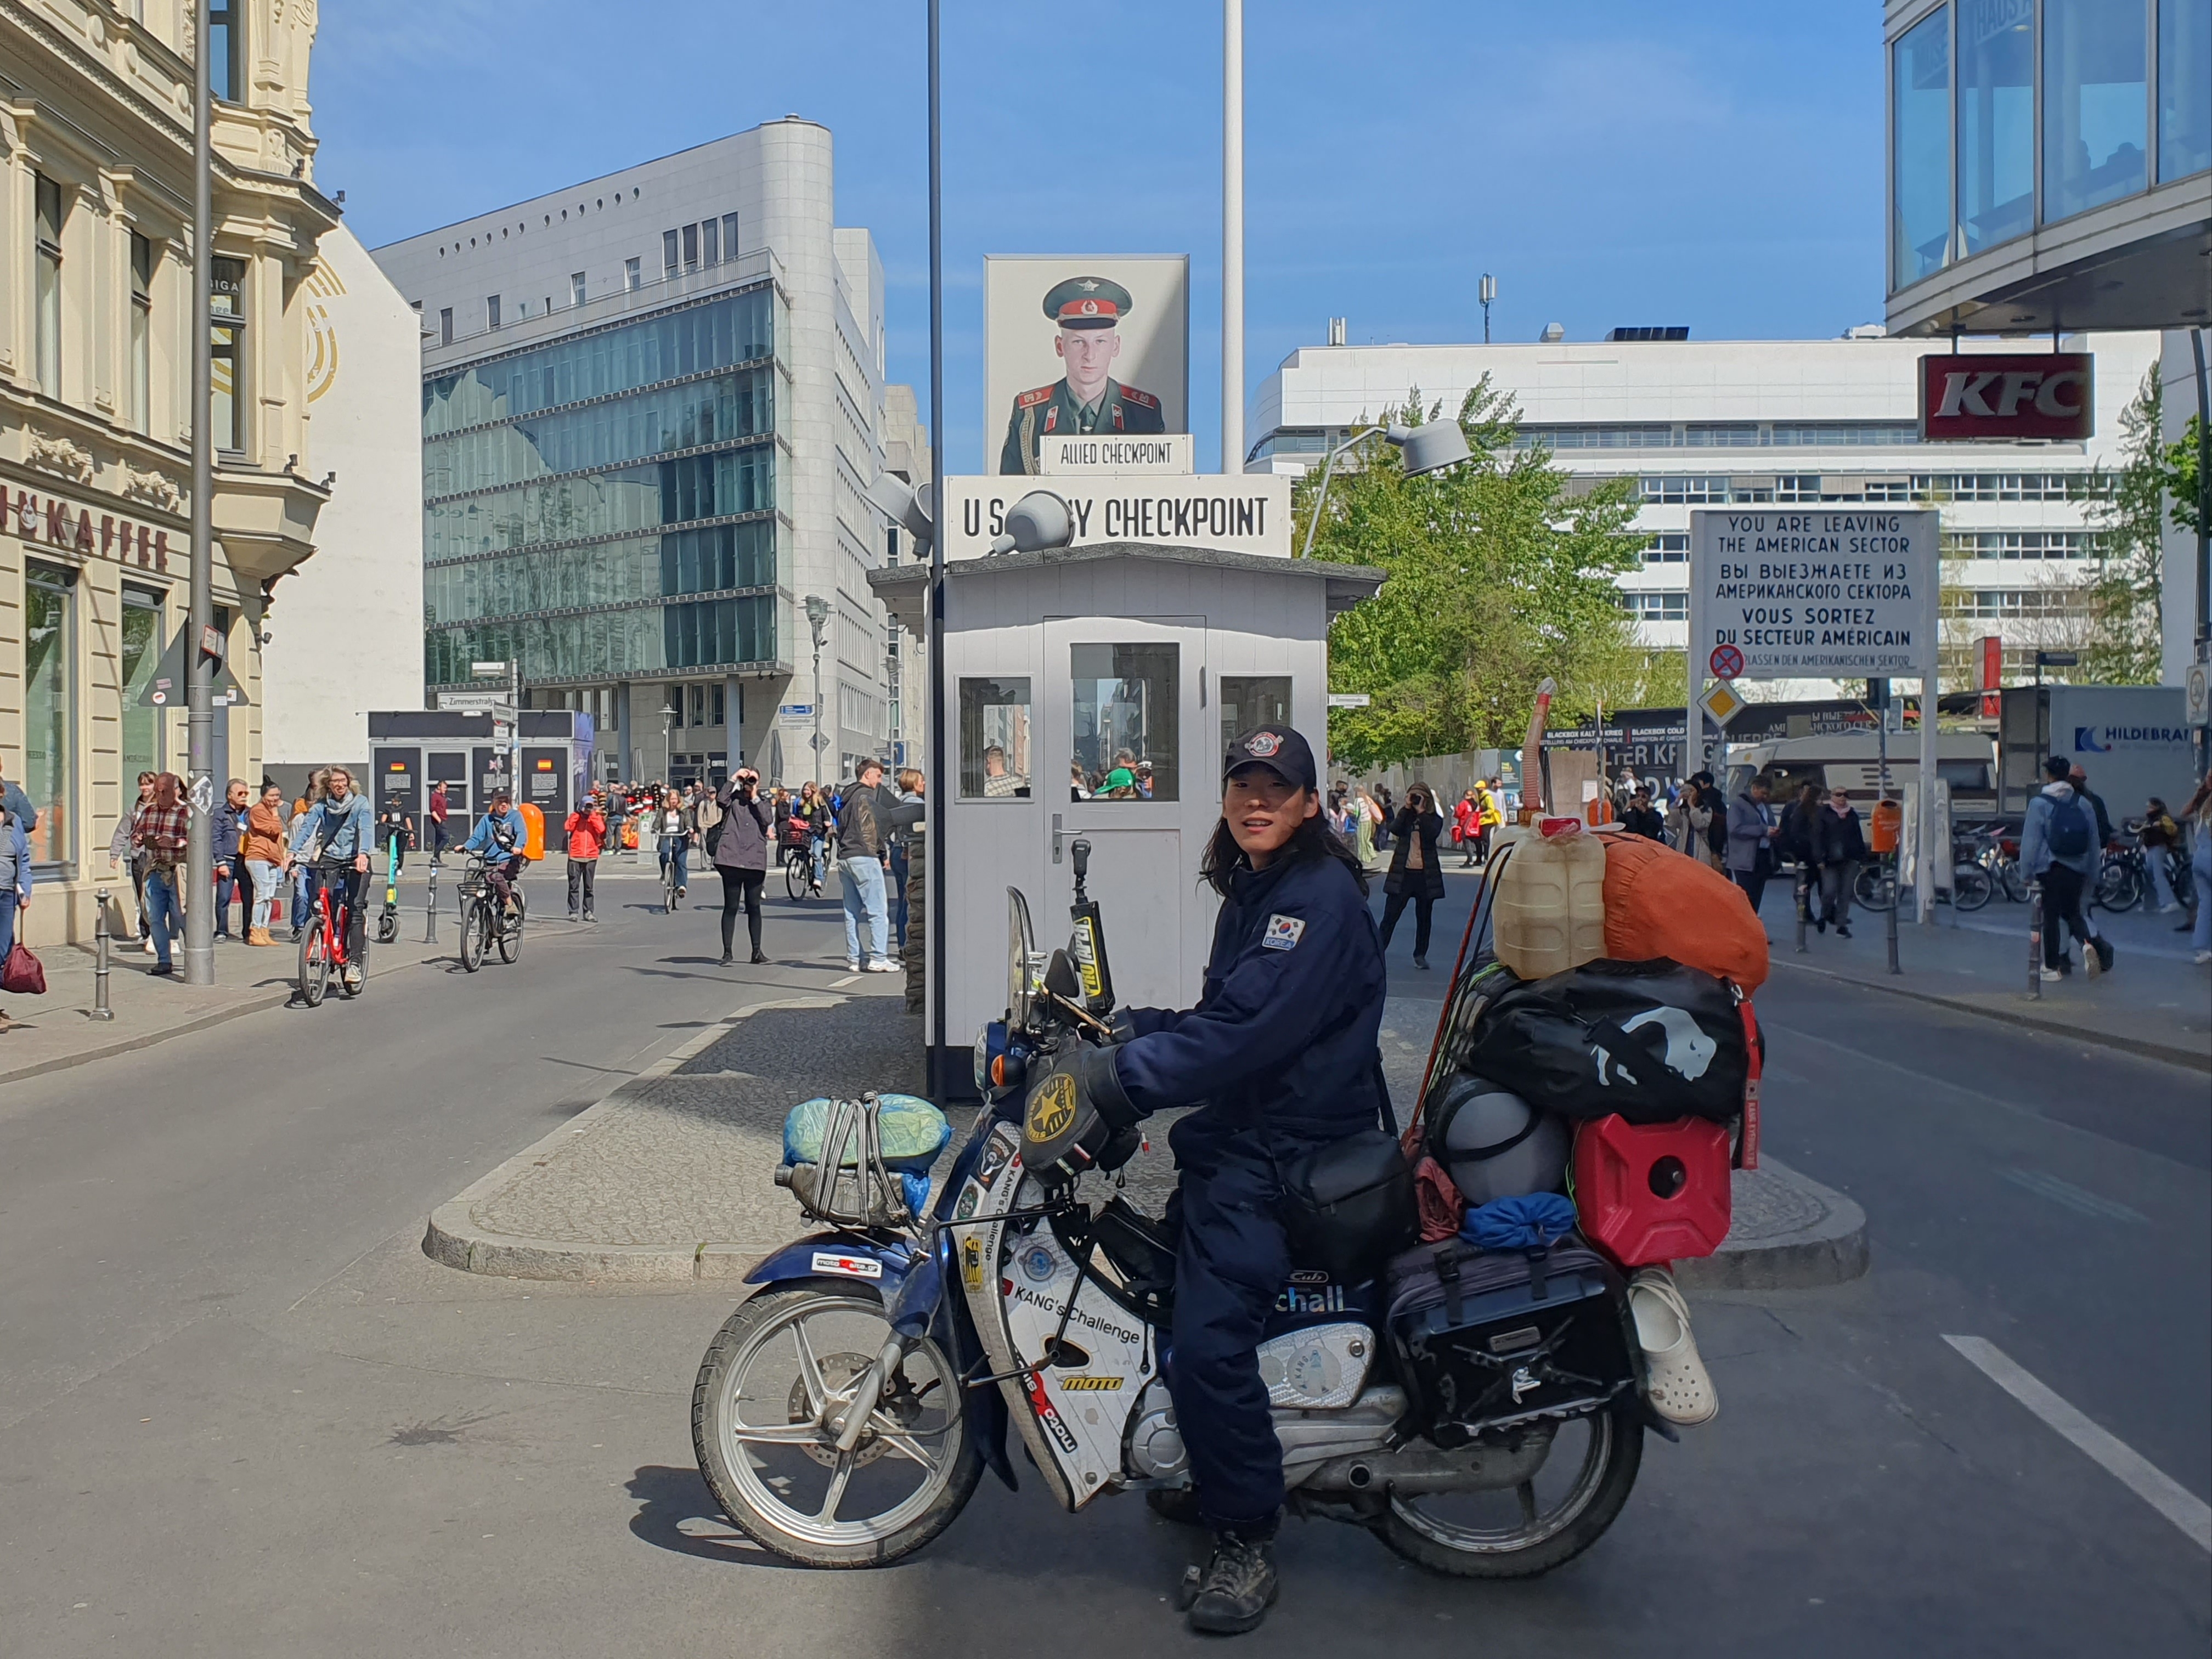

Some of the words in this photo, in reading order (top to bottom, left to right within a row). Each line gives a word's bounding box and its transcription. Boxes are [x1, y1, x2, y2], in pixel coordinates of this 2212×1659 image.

[1934, 371, 2084, 417] KFC
[1061, 443, 1097, 464] ALLIED
[1102, 442, 1172, 464] CHECKPOINT
[1105, 497, 1268, 537] CHECKPOINT
[1728, 516, 1765, 532] YOU
[1776, 516, 1811, 532] ARE
[1825, 516, 1900, 532] LEAVING
[1719, 537, 1746, 553] THE
[1756, 537, 1839, 553] AMERICAN
[1849, 537, 1910, 553] SECTOR
[1721, 564, 1748, 579] ВЫ
[1760, 564, 1871, 579] ВЫЕЗЖАЕТЕ
[1884, 564, 1906, 579] ИЗ
[1716, 584, 1840, 600] АМЕРИКАНСКОГО
[1848, 584, 1911, 600] СЕКТОРА
[1742, 608, 1793, 624] VOUS
[1804, 608, 1875, 624] SORTEZ
[1716, 629, 1736, 645] DU
[1743, 629, 1815, 645] SECTEUR
[1822, 627, 1910, 646] AMÉRICAIN
[1781, 654, 1798, 666] DEN
[1801, 654, 1875, 667] AMERIKANISCHEN
[1878, 655, 1910, 667] SEKTOR
[1547, 730, 1579, 738] BLACKBOX
[1632, 727, 1666, 736] BLACKBOX
[1265, 936, 1293, 949] KOREA
[1275, 1285, 1344, 1312] chall
[1014, 1286, 1066, 1316] KANG's
[1069, 1307, 1140, 1344] Challenge
